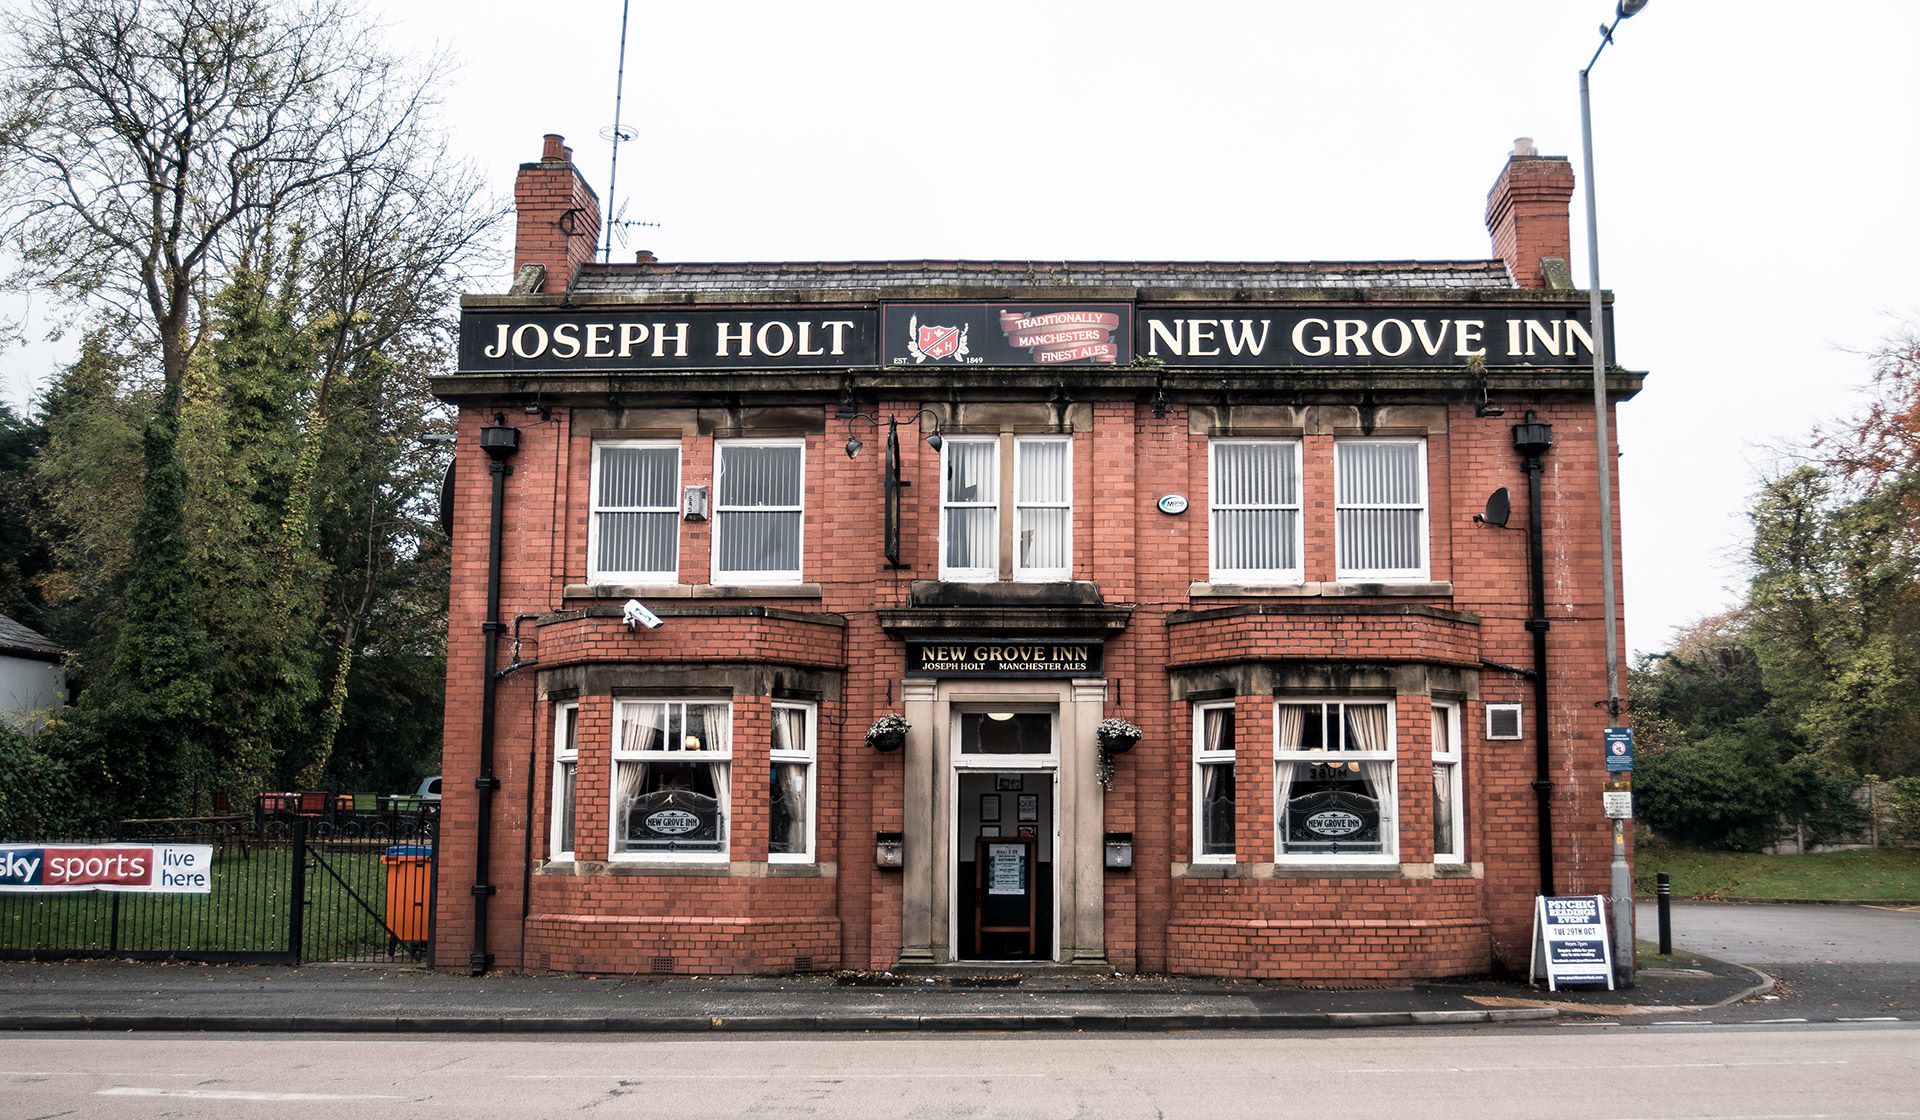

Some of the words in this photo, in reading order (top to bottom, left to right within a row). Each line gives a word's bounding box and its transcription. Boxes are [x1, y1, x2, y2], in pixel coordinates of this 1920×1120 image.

[1015, 313, 1103, 329] TRADITIONALLY
[484, 322, 690, 359] JOSEPH
[715, 320, 855, 357] HOLT
[1018, 330, 1100, 347] MANCHESTERS
[1147, 318, 1271, 356] NEW
[1291, 317, 1487, 357] GROVE
[1506, 319, 1594, 356] INN
[1041, 349, 1078, 362] FINEST
[1080, 345, 1109, 356] ALES
[921, 646, 968, 662] NEW
[973, 646, 1046, 662] GROVE
[1052, 646, 1088, 662] INN
[922, 662, 959, 671] JOSEPH
[960, 662, 985, 671] HOLT
[999, 662, 1062, 671] MANCHESTER
[1062, 662, 1087, 671] ALES
[648, 818, 662, 827] NEW
[663, 818, 684, 827] GROVE
[685, 818, 697, 827] INN
[1308, 819, 1323, 828] NEW
[1324, 819, 1346, 828] GROVE
[1347, 819, 1360, 828] INN
[163, 849, 195, 867] live
[50, 853, 145, 882] sports
[162, 870, 205, 887] here
[1548, 900, 1595, 909] PSYCHIC
[1557, 916, 1589, 924] EVENT
[1554, 928, 1566, 936] TUE
[1567, 928, 1583, 936] 29TH
[1584, 928, 1596, 936] OCT
